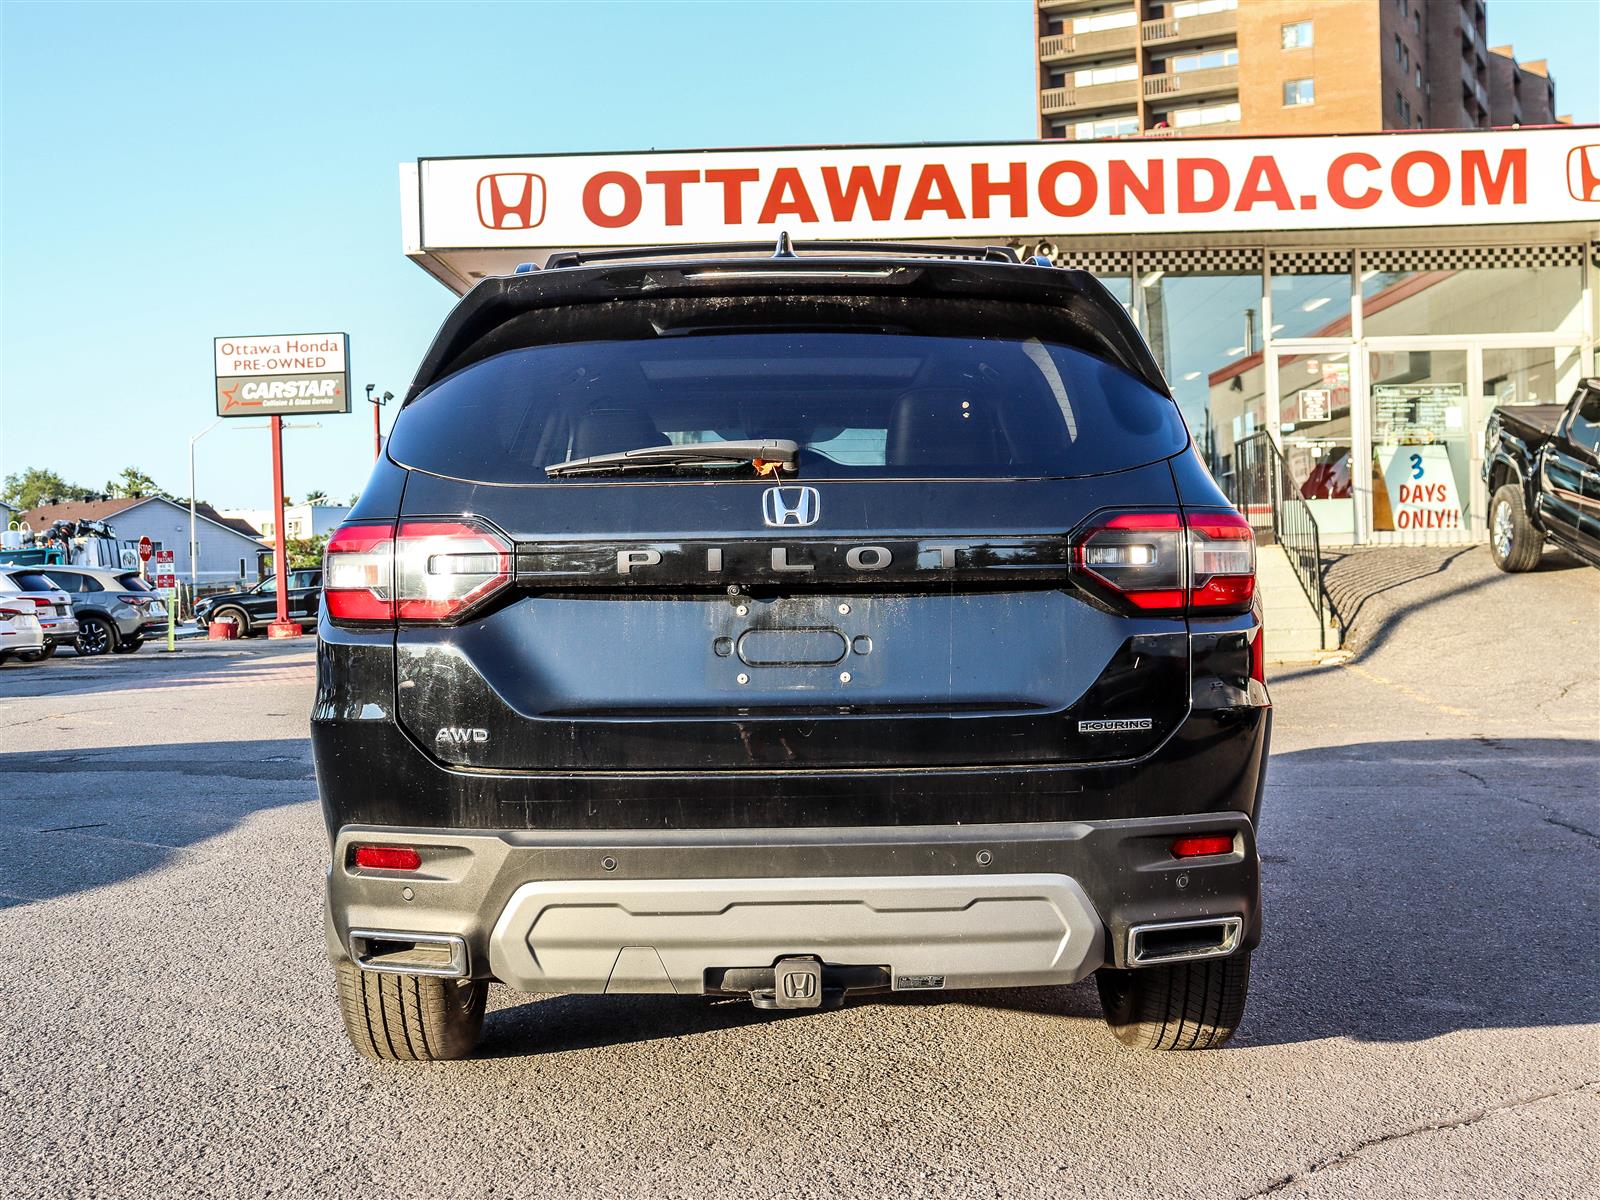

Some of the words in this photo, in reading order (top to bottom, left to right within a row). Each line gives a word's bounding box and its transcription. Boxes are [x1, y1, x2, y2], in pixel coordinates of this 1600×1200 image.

[582, 148, 1527, 228] OTTAWAHONDA.COM
[221, 342, 281, 356] Ottawa
[286, 339, 339, 353] Honda
[233, 356, 326, 371] PRE-OWNED
[241, 379, 337, 400] CARSTAR
[1409, 453, 1425, 480] 3
[1399, 483, 1447, 503] DAYS
[1397, 509, 1459, 529] ONLY!!
[140, 544, 152, 555] STOP
[616, 545, 970, 575] PILOT
[434, 727, 489, 743] AWD
[1080, 720, 1150, 731] TOURING
